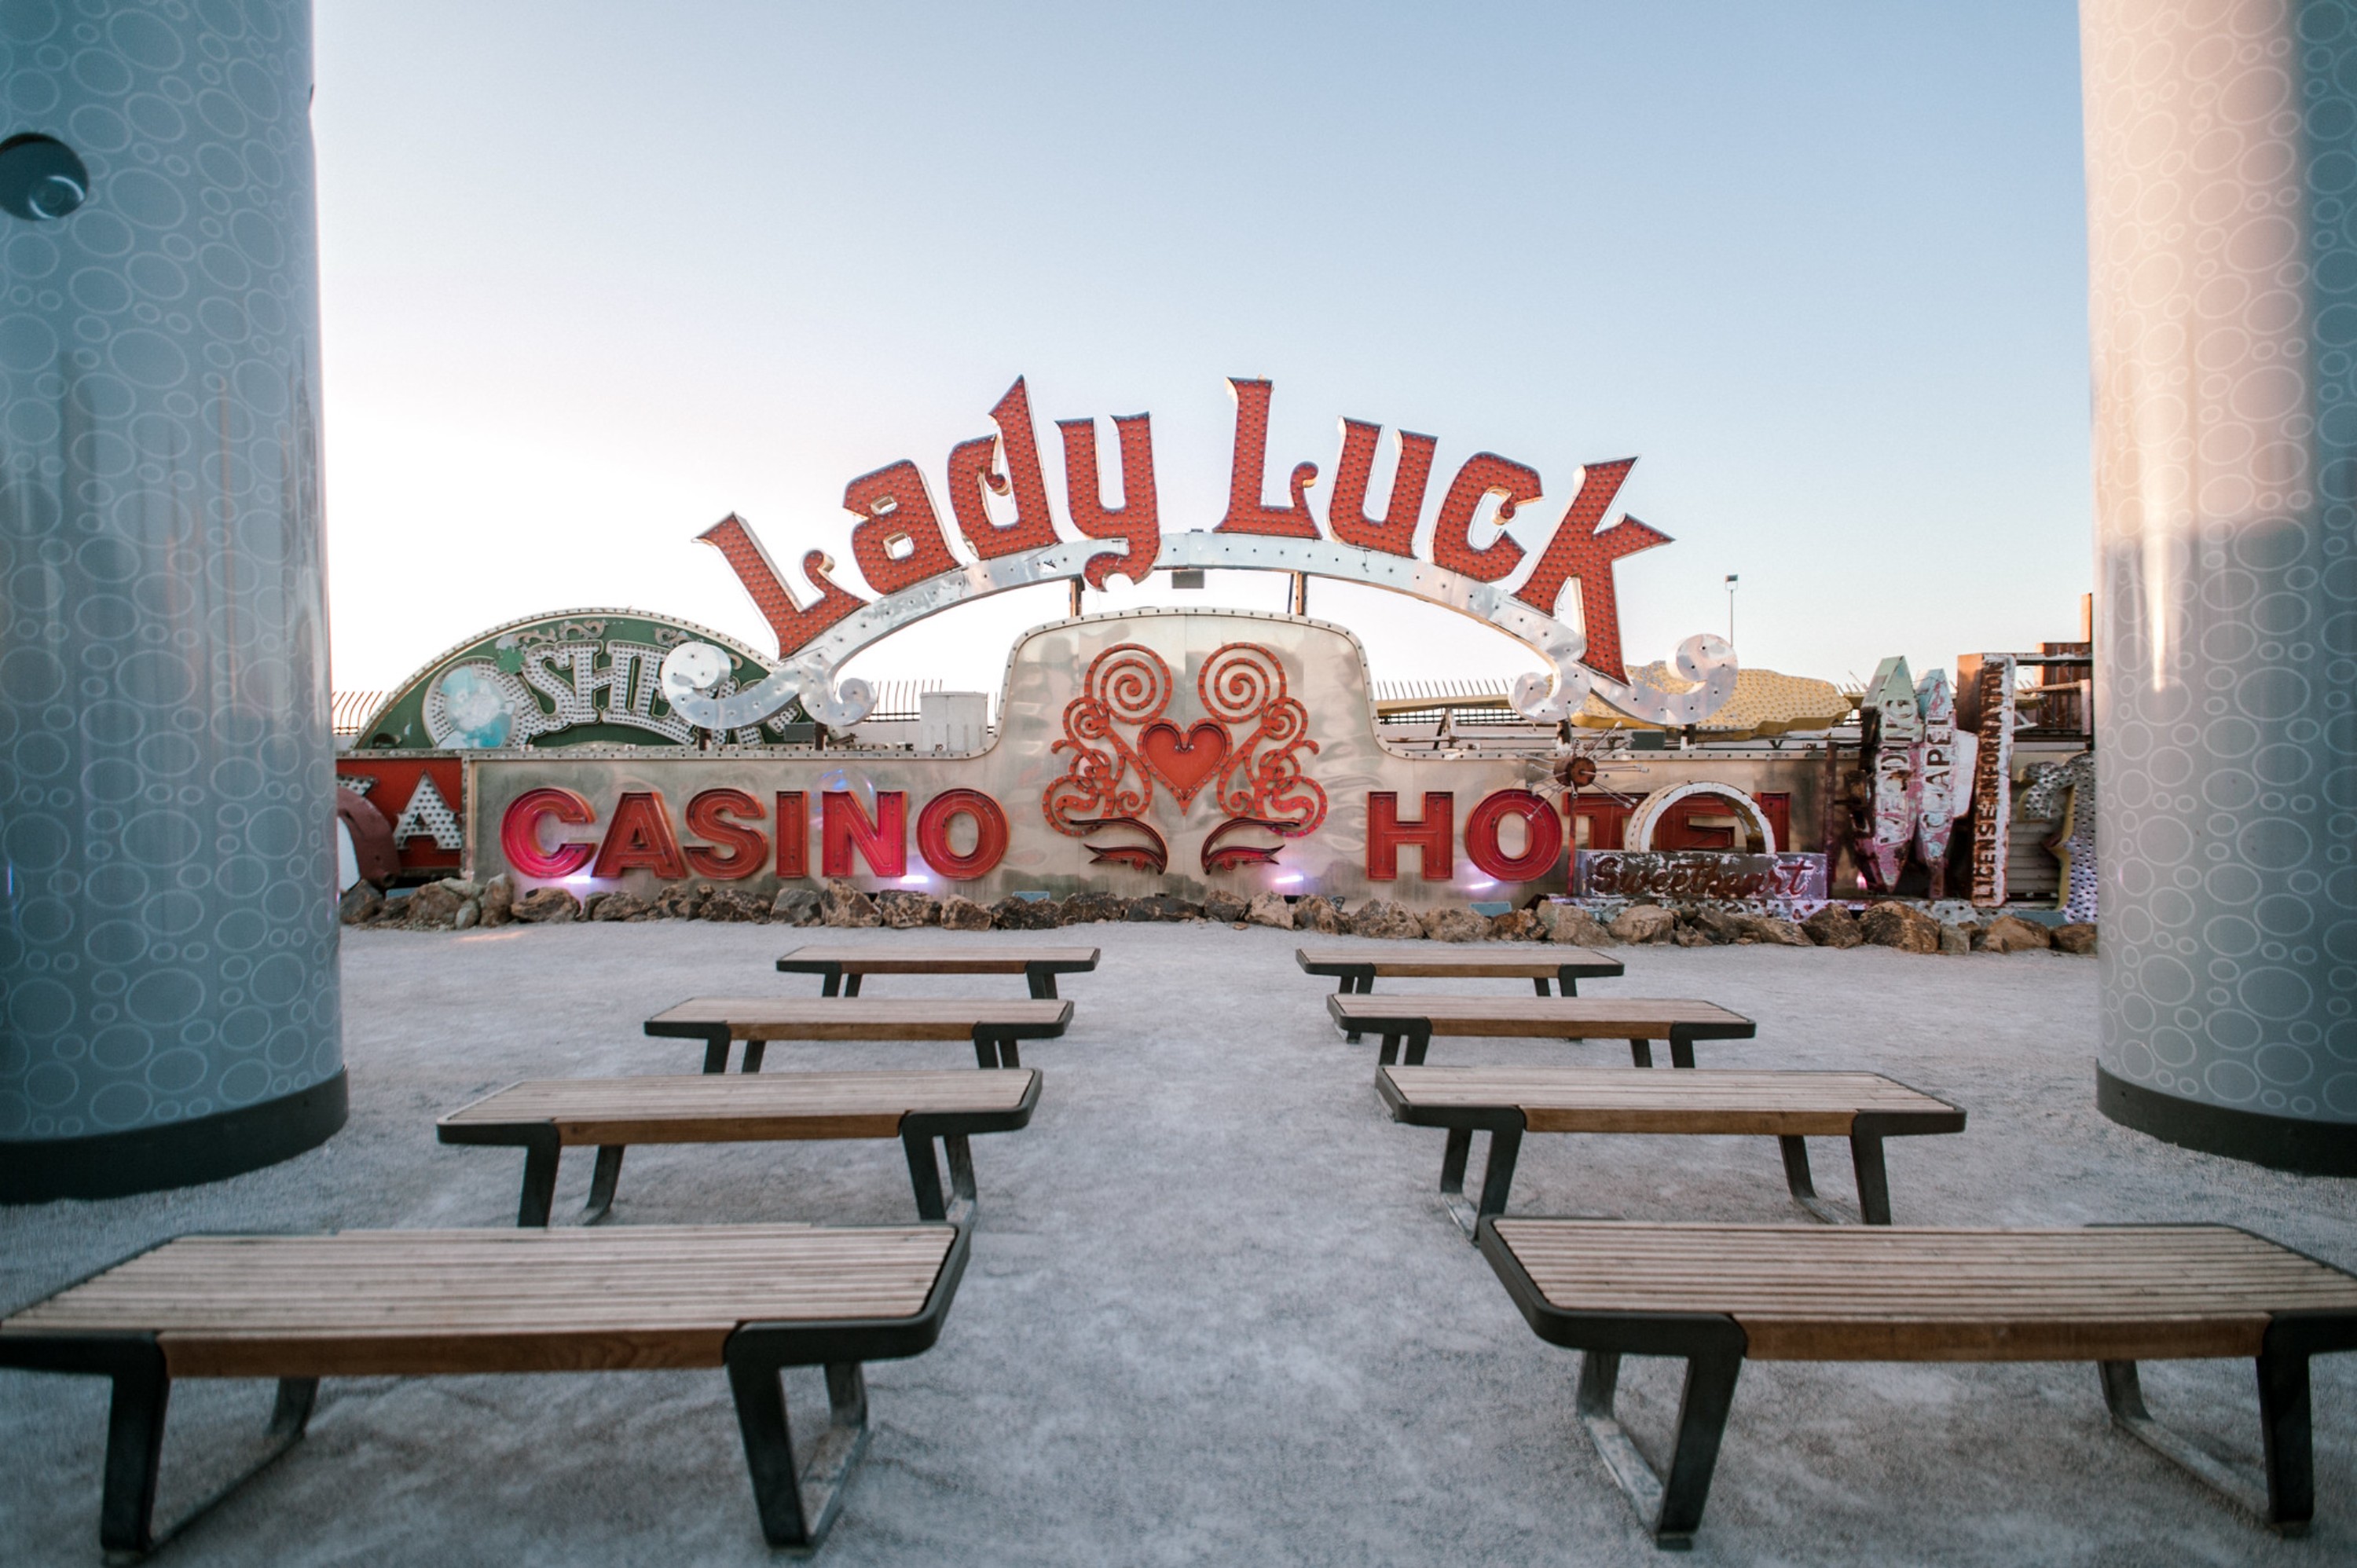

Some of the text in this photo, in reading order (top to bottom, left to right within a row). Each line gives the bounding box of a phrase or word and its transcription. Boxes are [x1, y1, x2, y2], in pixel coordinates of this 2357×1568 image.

[694, 374, 1676, 686] Lady Luck
[500, 787, 1010, 881] CASINO
[1973, 661, 2004, 900] LICENSE INFORMATION
[1593, 857, 1813, 899] Sweetheart
